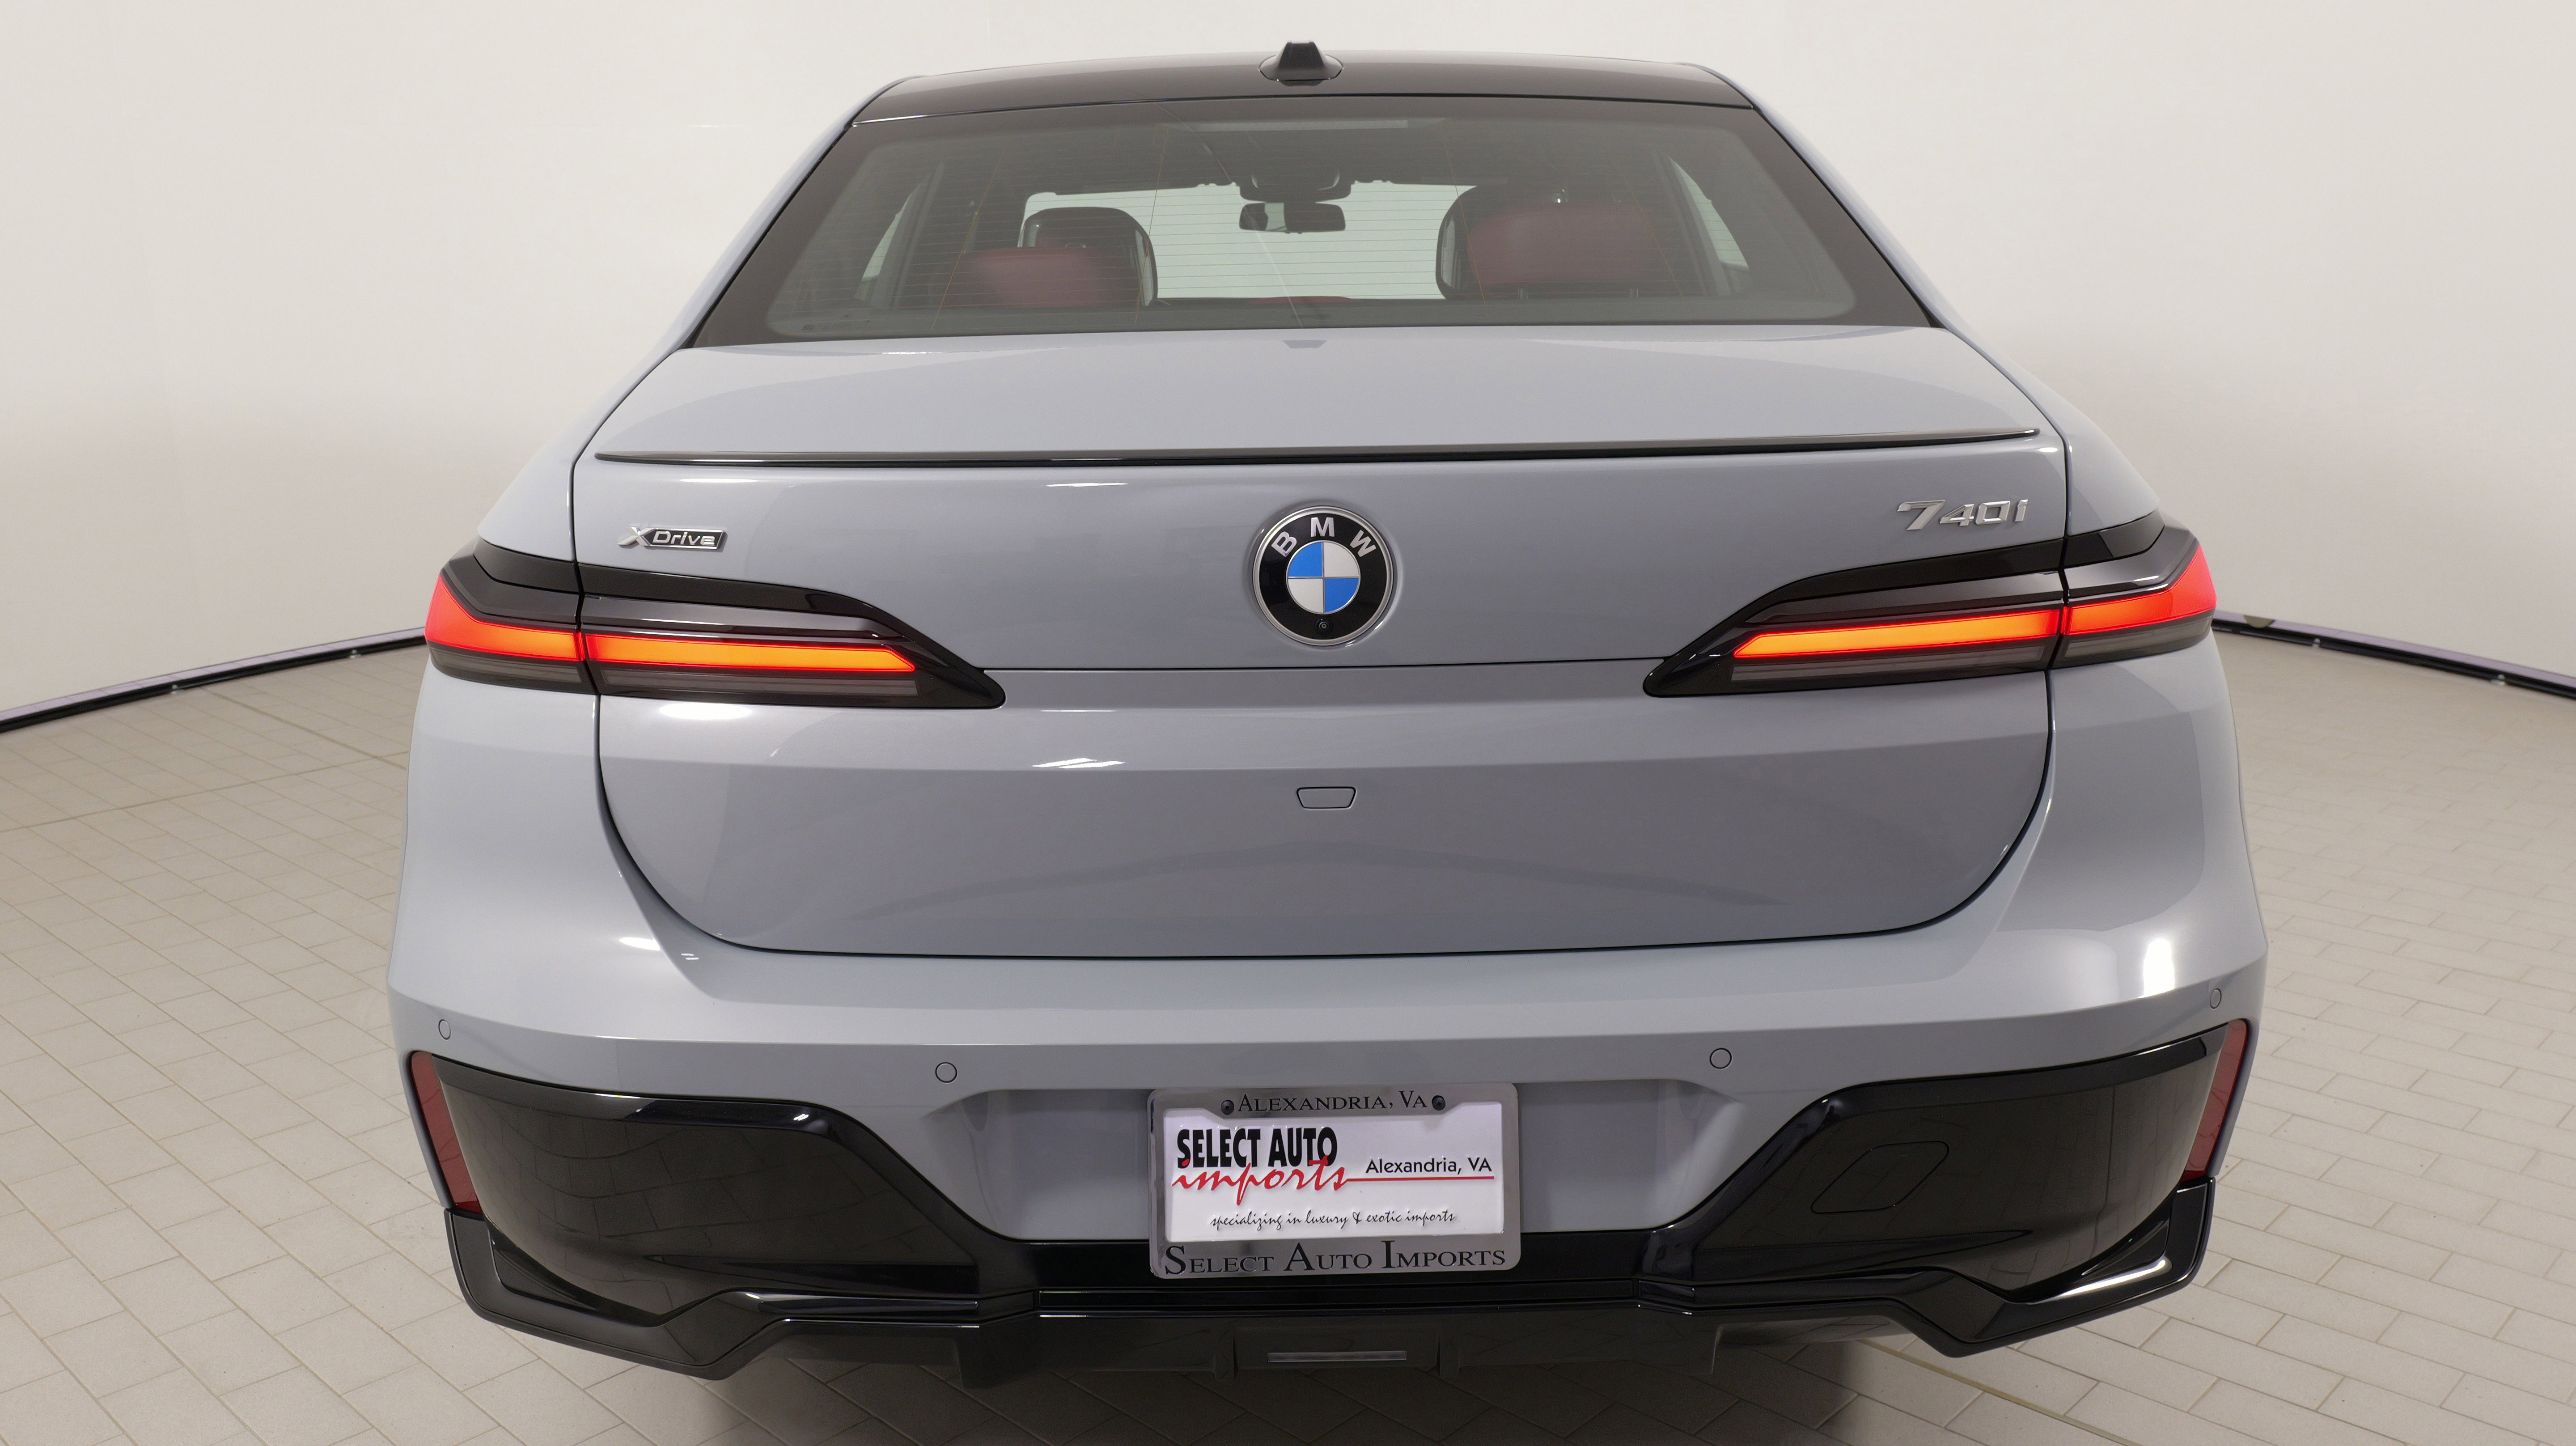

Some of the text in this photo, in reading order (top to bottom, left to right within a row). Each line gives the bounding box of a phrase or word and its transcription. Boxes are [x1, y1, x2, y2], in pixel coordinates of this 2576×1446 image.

[1271, 517, 1377, 558] BMW
[1177, 1127, 1338, 1168] SELECT AUTO
[1365, 1157, 1492, 1175] Alexandria, VA
[1172, 1155, 1349, 1205] imports
[1210, 1209, 1455, 1231] specializing in luxury & exotic imports
[1165, 1240, 1506, 1275] SELECT AUTO IMPORTS
